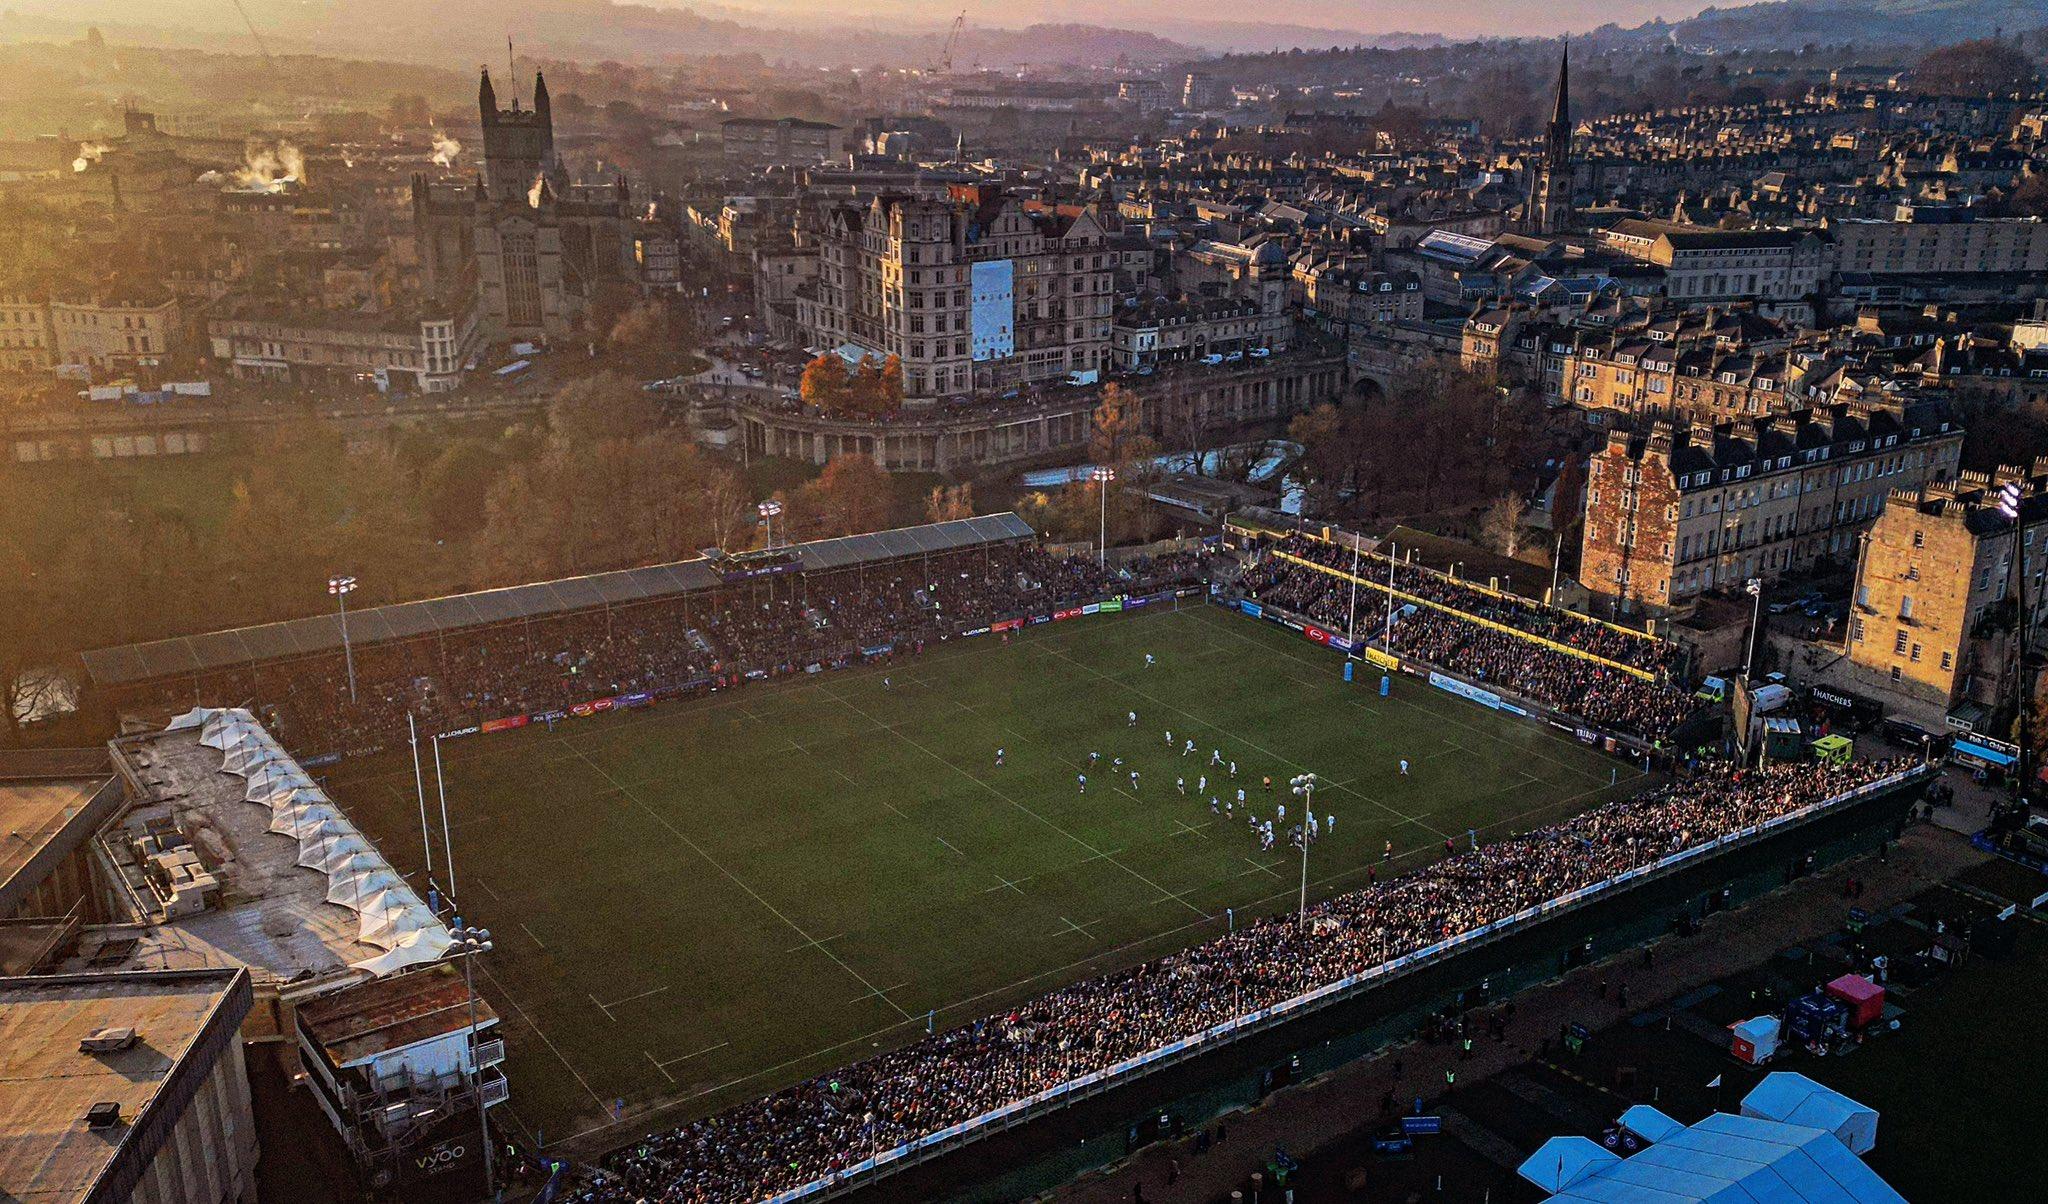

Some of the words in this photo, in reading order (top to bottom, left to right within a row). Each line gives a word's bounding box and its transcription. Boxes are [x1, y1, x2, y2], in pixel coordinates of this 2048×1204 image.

[1813, 687, 1852, 708] THATCHERS
[1989, 741, 2006, 752] Chips
[415, 1145, 465, 1169] vyoo
